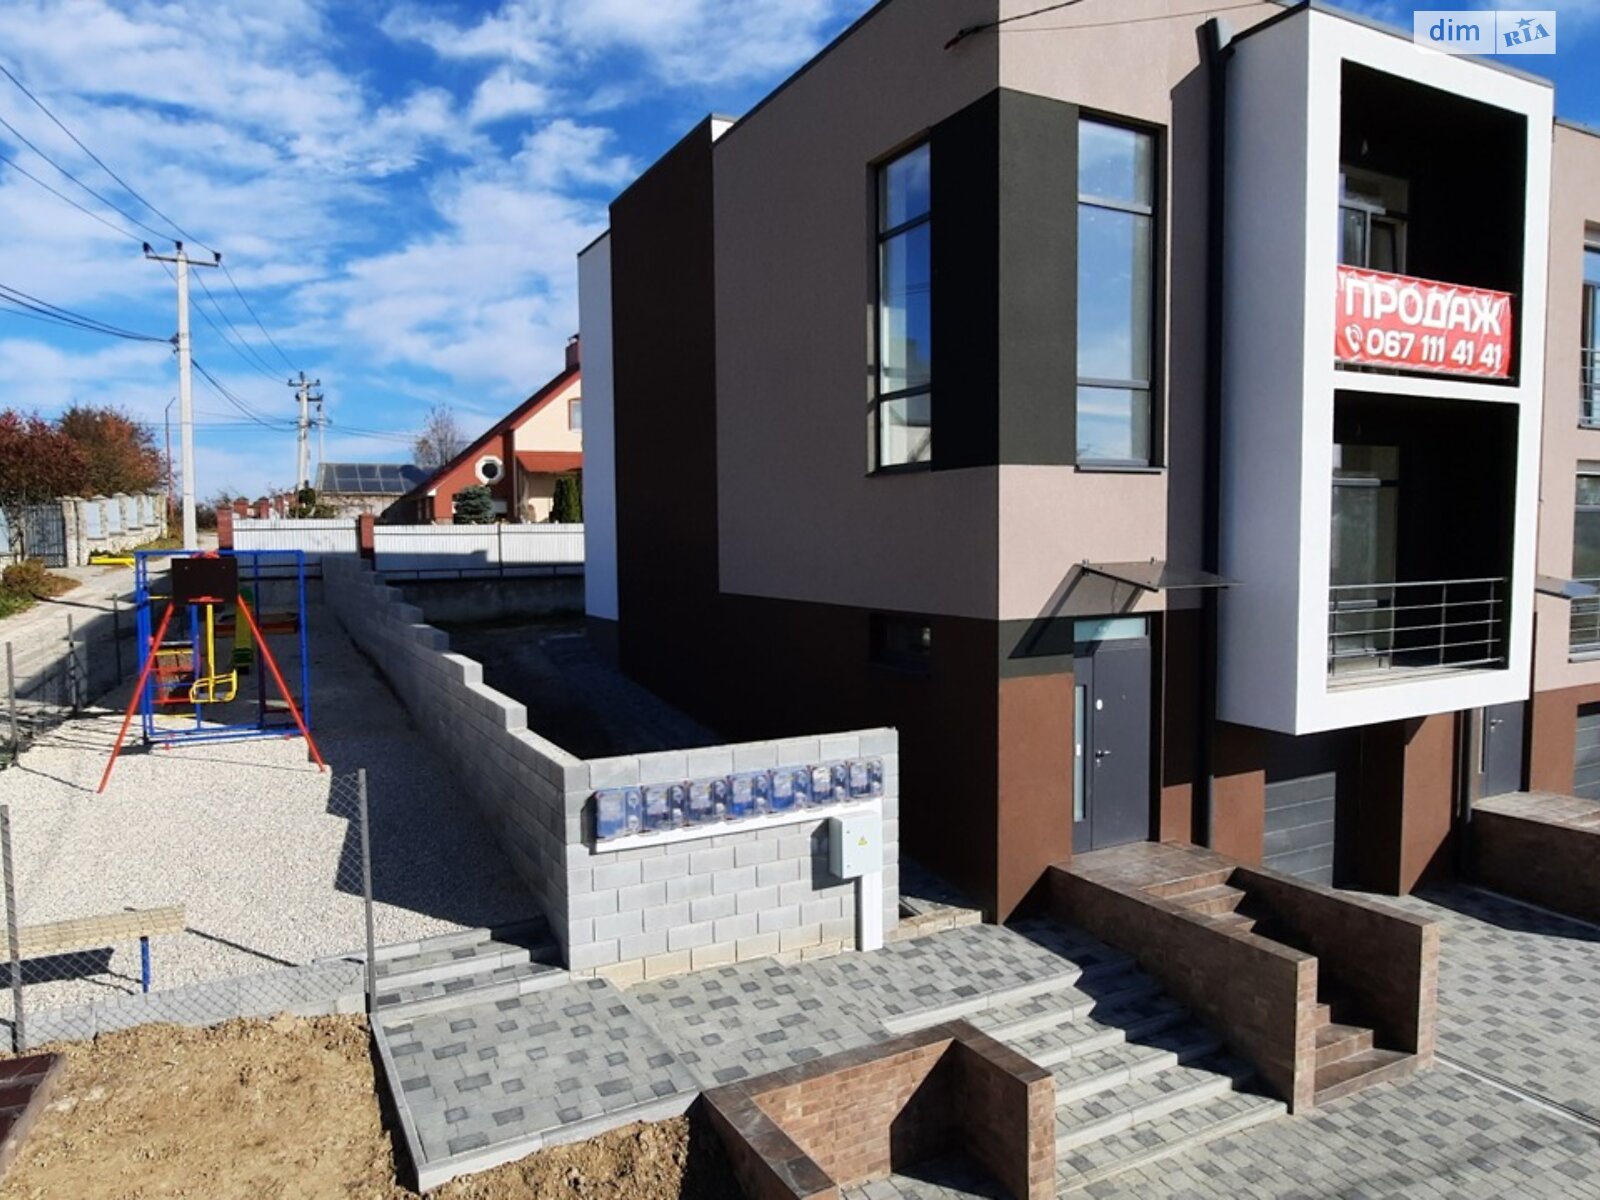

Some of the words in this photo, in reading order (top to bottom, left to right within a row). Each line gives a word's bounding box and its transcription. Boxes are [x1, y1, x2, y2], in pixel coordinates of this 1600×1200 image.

[1345, 277, 1501, 336] ПРОДАЖ
[1366, 328, 1415, 359] 067
[1420, 334, 1446, 363] 111
[1451, 339, 1474, 366] 41
[1479, 342, 1503, 369] 41
